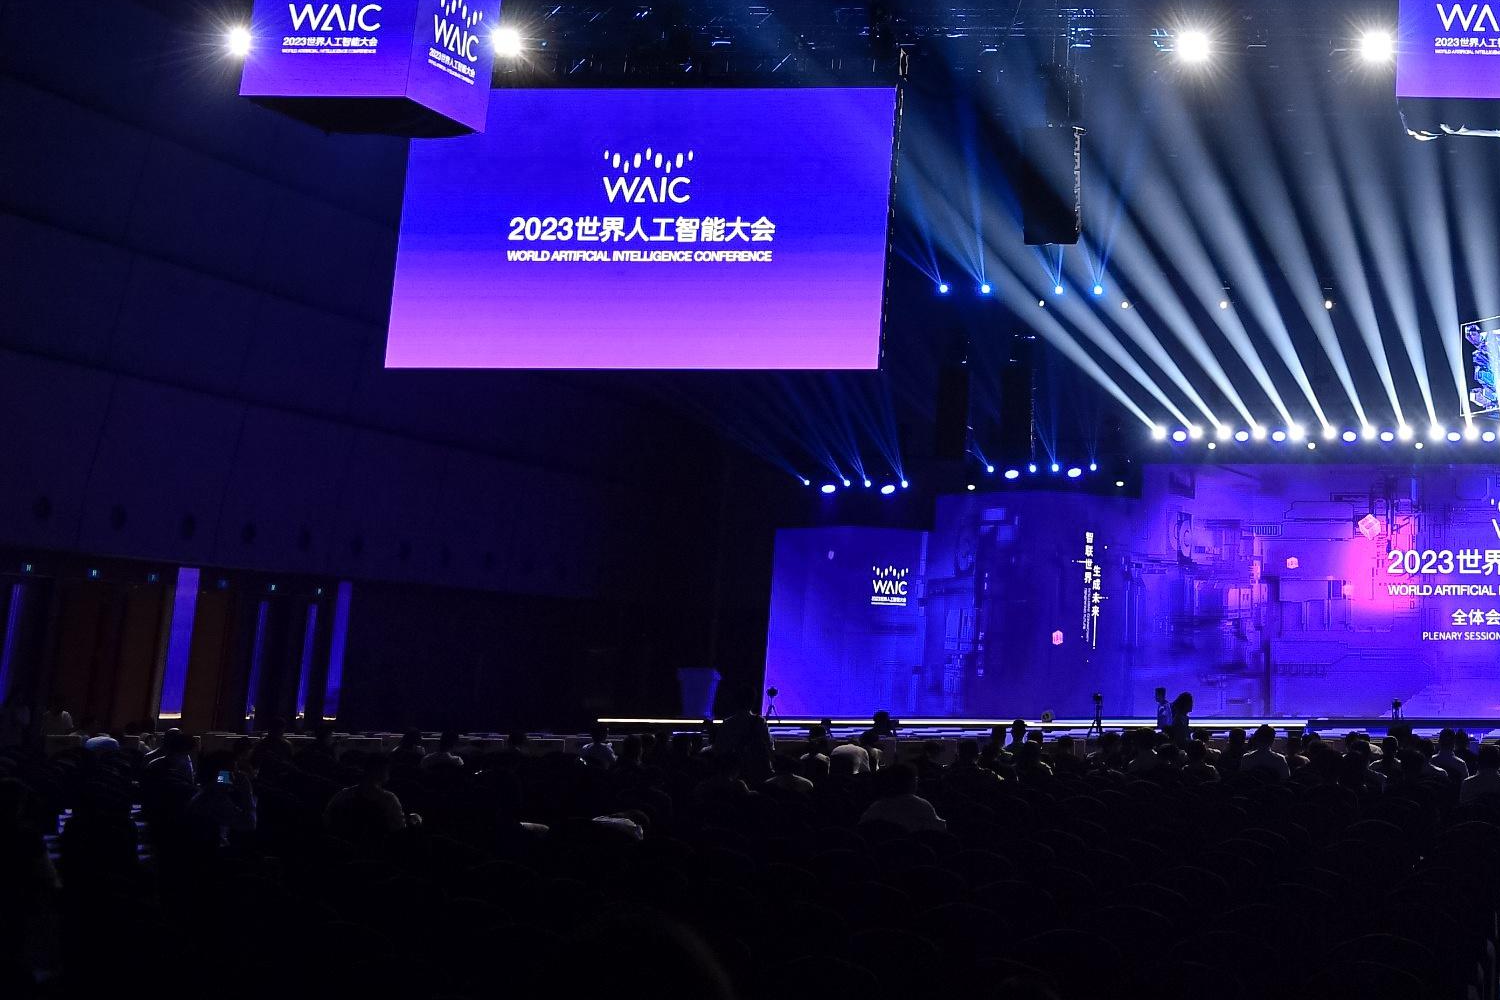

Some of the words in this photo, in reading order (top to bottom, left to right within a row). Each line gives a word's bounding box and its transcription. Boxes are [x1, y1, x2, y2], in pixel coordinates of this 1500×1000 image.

[288, 3, 383, 32] WAIC
[434, 14, 479, 62] WAIC
[603, 176, 691, 204] WAIC
[507, 215, 776, 243] 2023世界人工智能大会
[507, 250, 549, 262] WORLD
[551, 250, 611, 262] ARTIFICIAL
[613, 250, 692, 262] INTELLIGENCE
[694, 250, 773, 262] CONFERENCE
[872, 579, 908, 596] WAIC
[1387, 585, 1432, 596] WORLD
[1434, 585, 1496, 596] ARTIFICIAL
[1422, 631, 1462, 641] PLENARY
